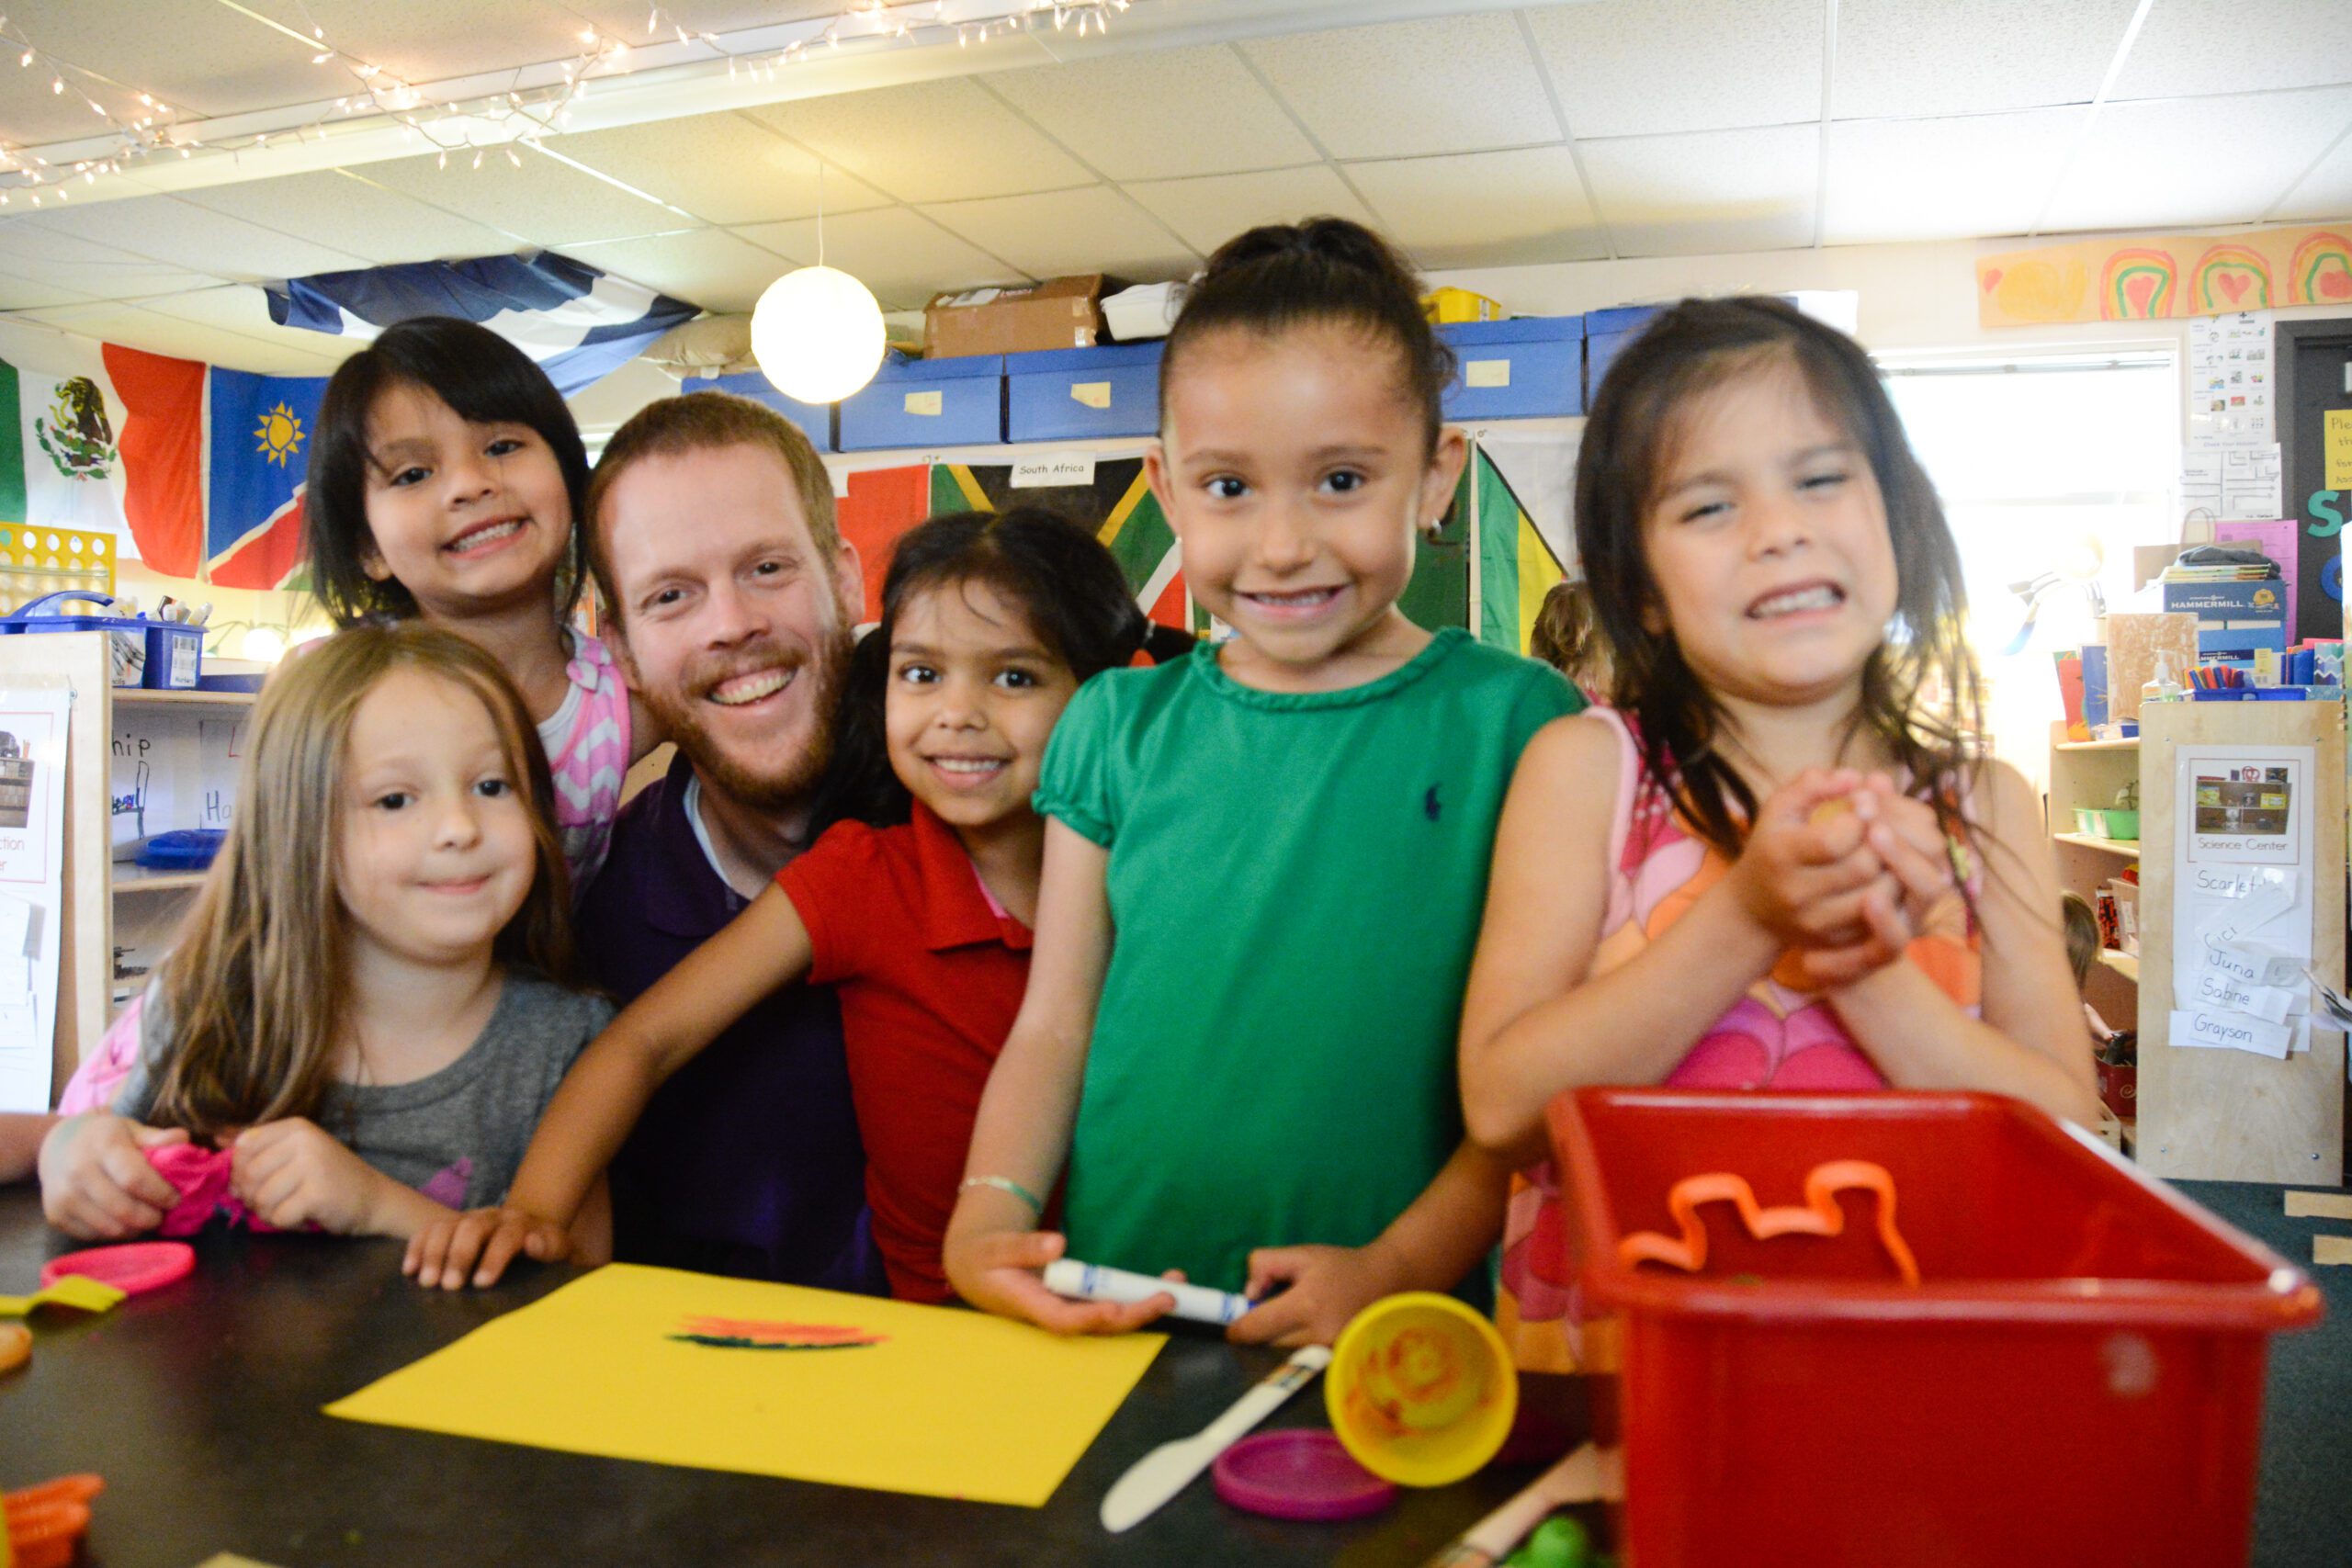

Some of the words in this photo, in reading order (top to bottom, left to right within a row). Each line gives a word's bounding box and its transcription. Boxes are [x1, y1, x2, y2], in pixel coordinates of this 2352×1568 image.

[1019, 465, 1047, 475] South
[1053, 464, 1084, 473] Africa
[2171, 600, 2244, 608] HAMMERMILL
[2198, 837, 2242, 850] Science
[2245, 838, 2288, 851] Center
[2209, 951, 2255, 979] Juna
[2194, 1013, 2253, 1043] Grayson
